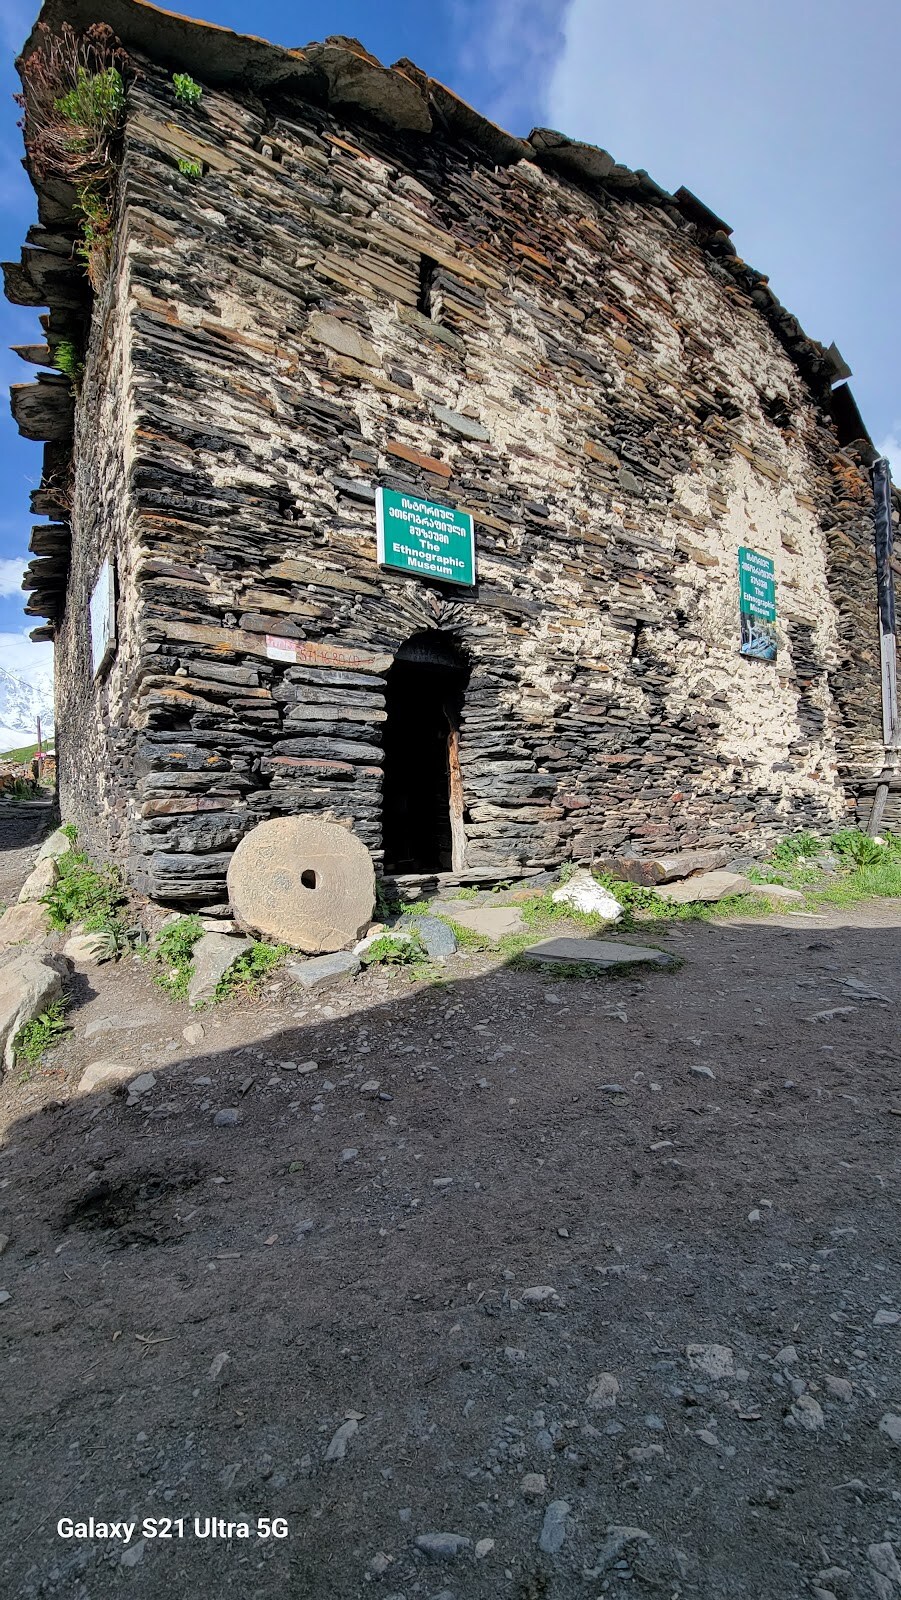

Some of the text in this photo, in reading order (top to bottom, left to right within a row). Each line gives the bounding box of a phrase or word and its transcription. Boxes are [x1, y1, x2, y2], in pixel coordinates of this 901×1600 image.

[401, 498, 455, 522] ისტორიულ
[389, 507, 466, 537] ეთნოგრაფიული
[409, 525, 449, 544] მუზეუმი
[419, 539, 440, 552] The
[392, 542, 465, 568] Ethnographic
[407, 557, 452, 575] Museum
[743, 592, 775, 609] Ethnographic
[754, 587, 764, 597] The
[750, 603, 769, 616] Museum
